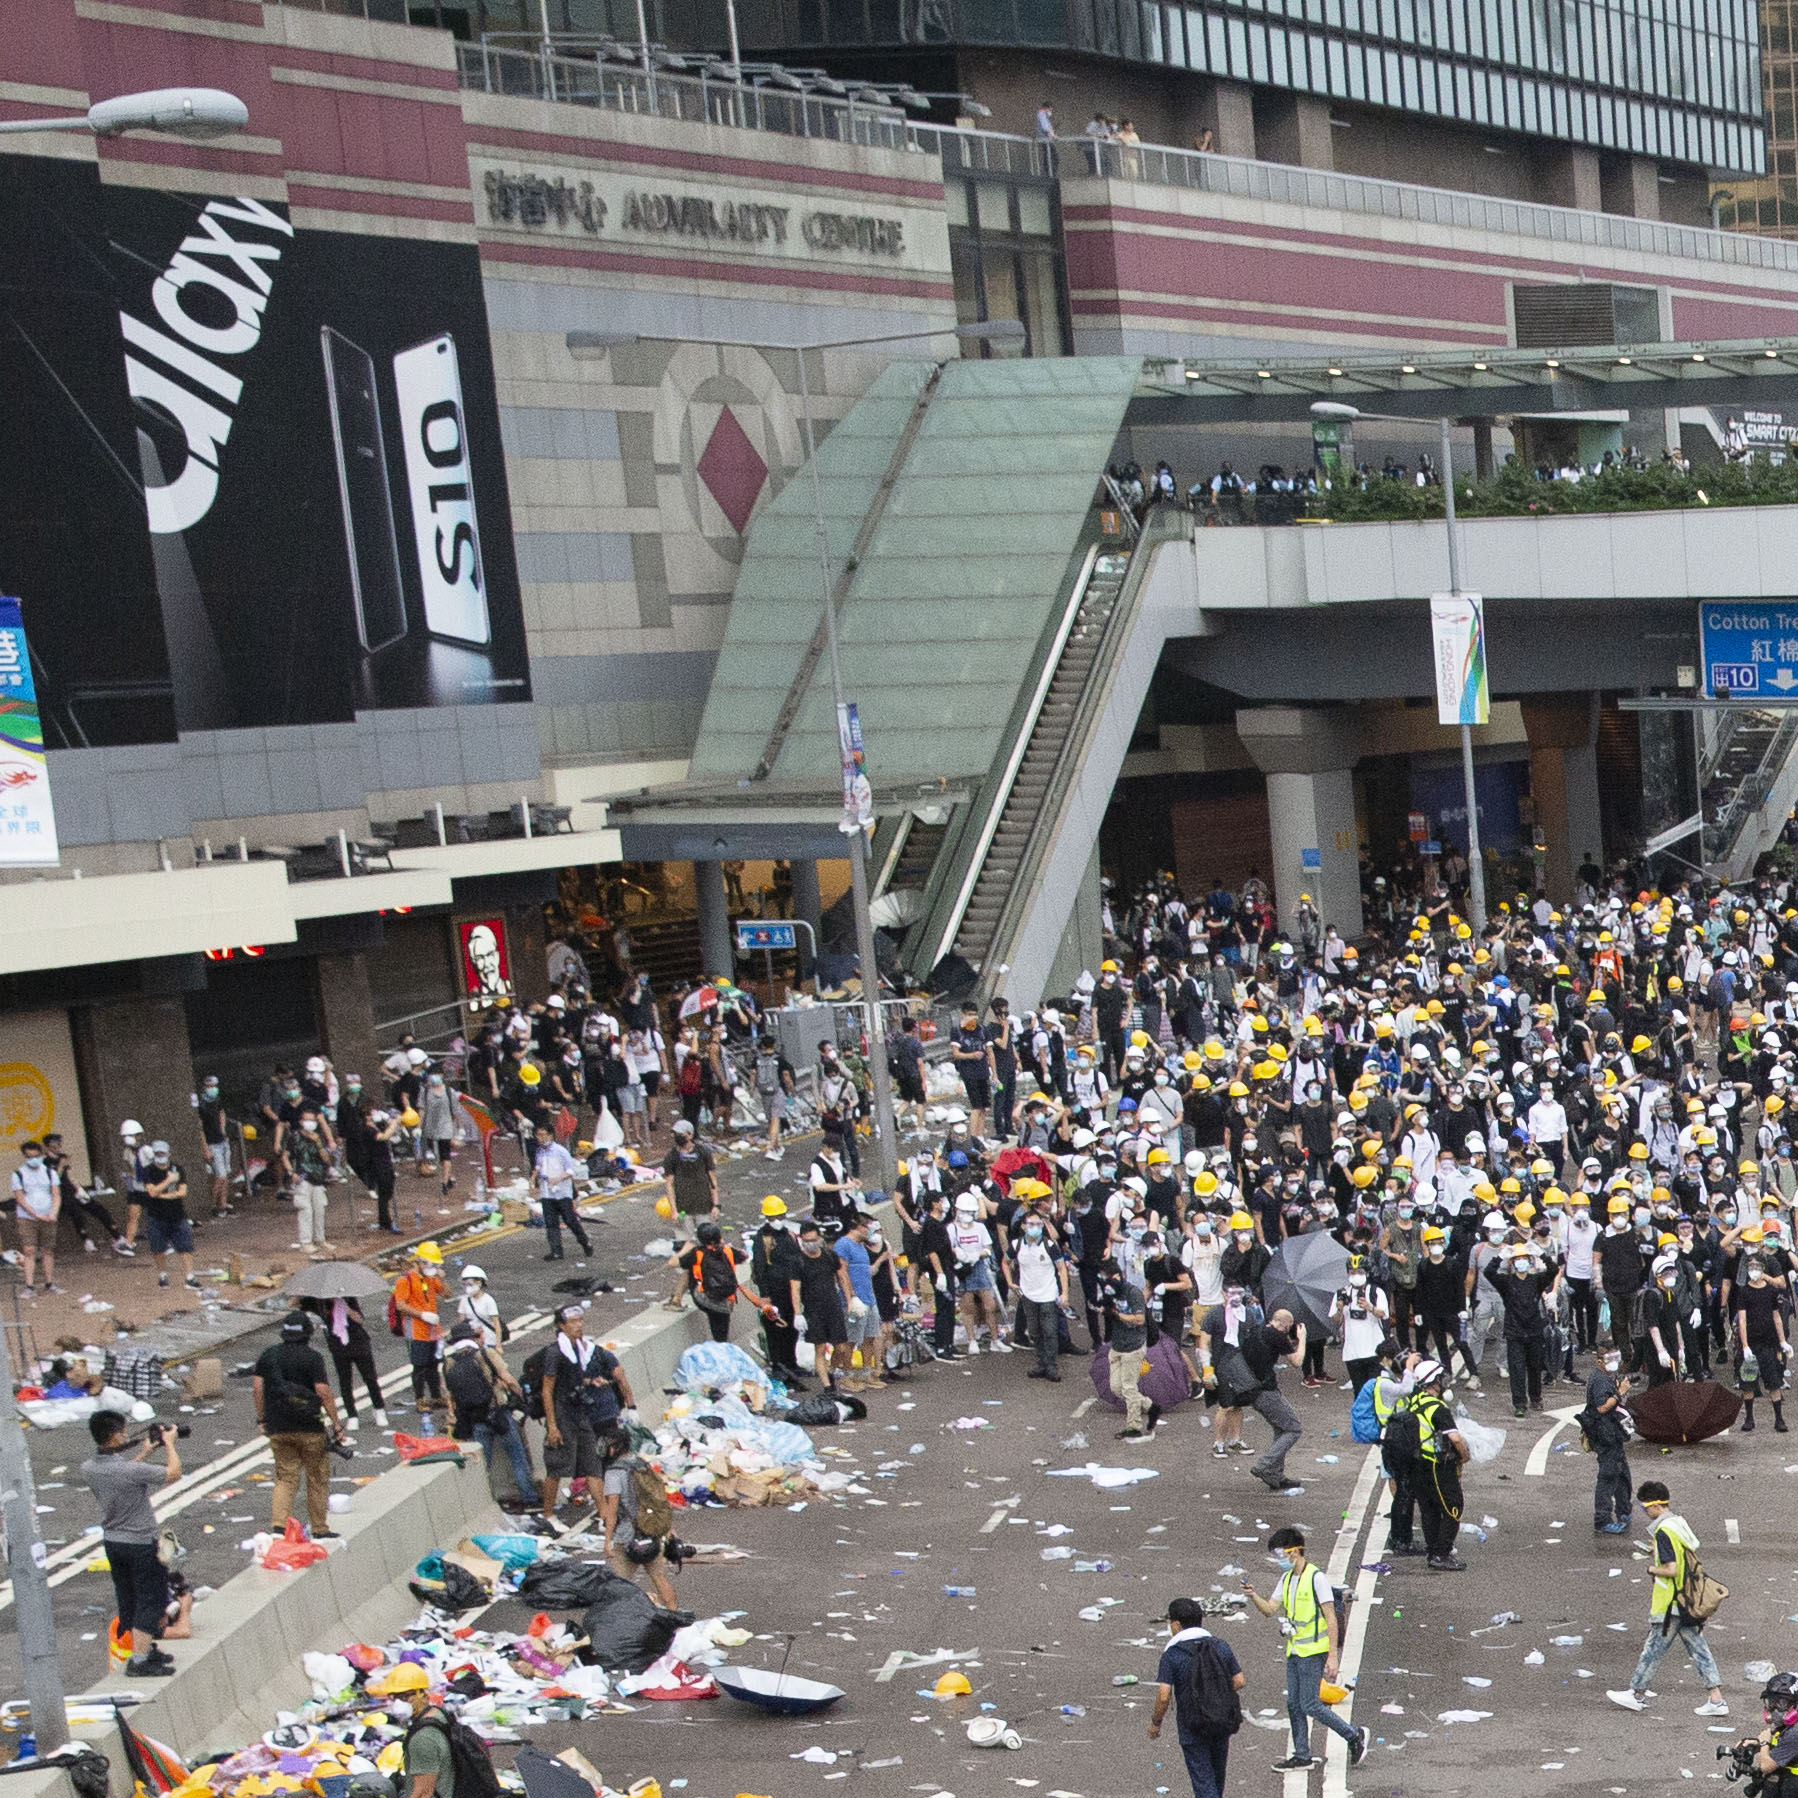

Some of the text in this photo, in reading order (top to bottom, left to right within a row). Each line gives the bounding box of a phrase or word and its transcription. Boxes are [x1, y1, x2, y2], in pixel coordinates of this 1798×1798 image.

[622, 190, 906, 257] ADMIRALTY CENTRE
[1746, 423, 1778, 440] SMART
[420, 400, 478, 592] S10
[1708, 613, 1769, 630] Cotton
[1731, 667, 1753, 687] 10
